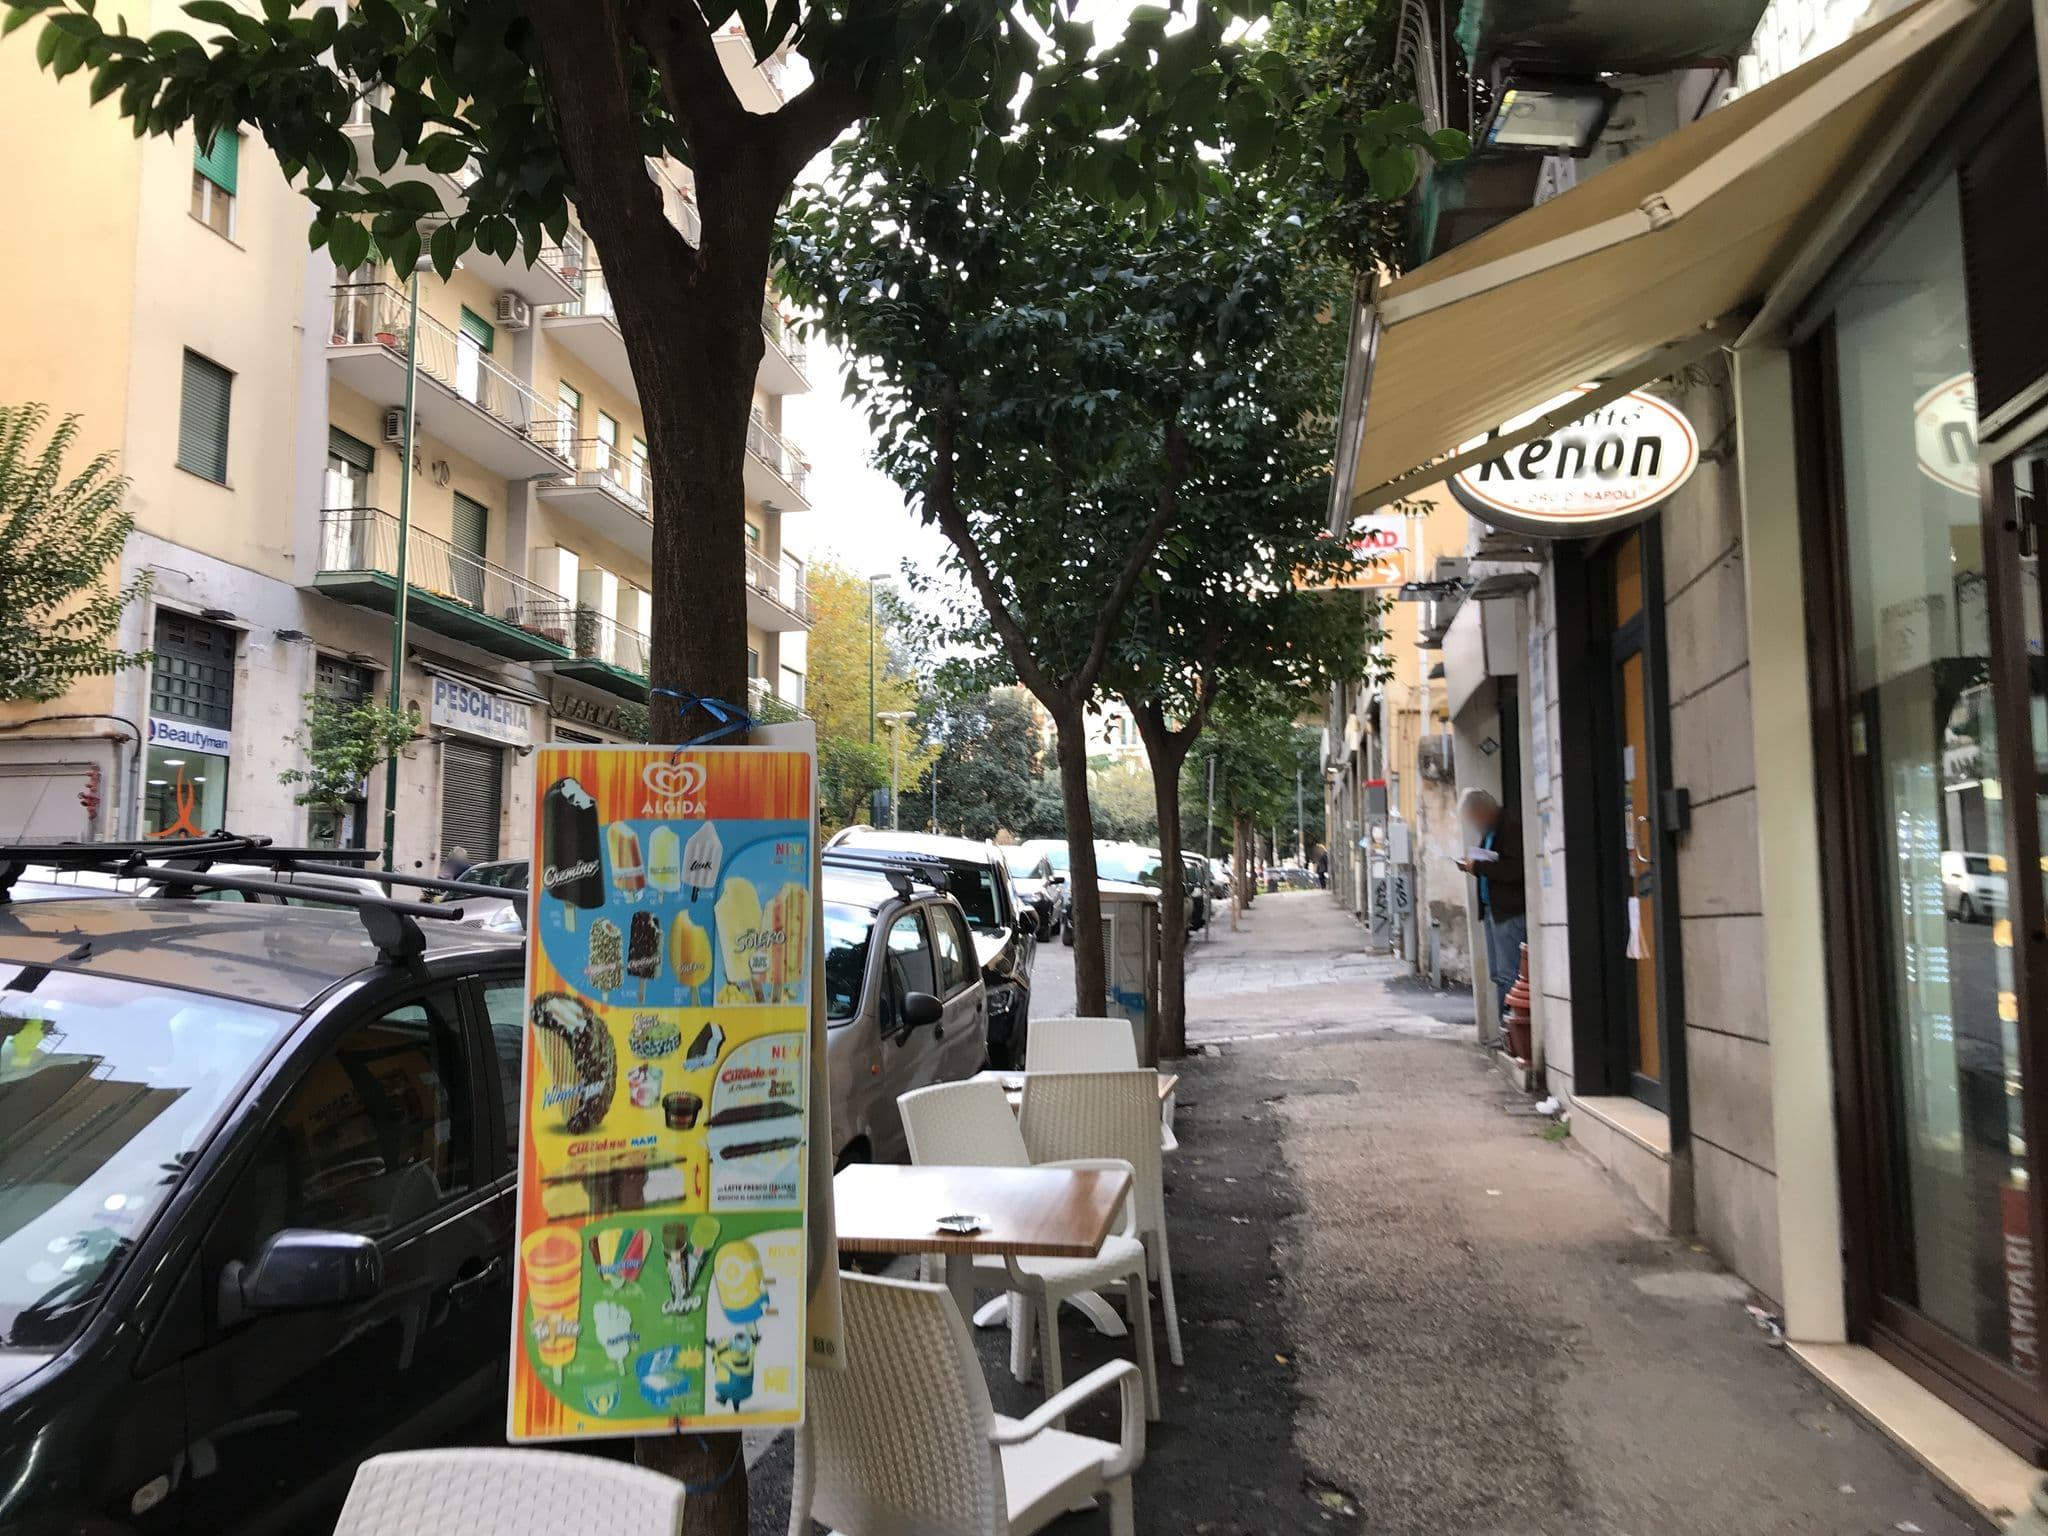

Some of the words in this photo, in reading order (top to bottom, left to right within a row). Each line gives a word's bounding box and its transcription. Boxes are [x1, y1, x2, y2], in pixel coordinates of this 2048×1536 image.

[434, 680, 529, 731] PESCHERIA
[641, 800, 707, 816] ALGIDA
[541, 861, 600, 888] Cremino
